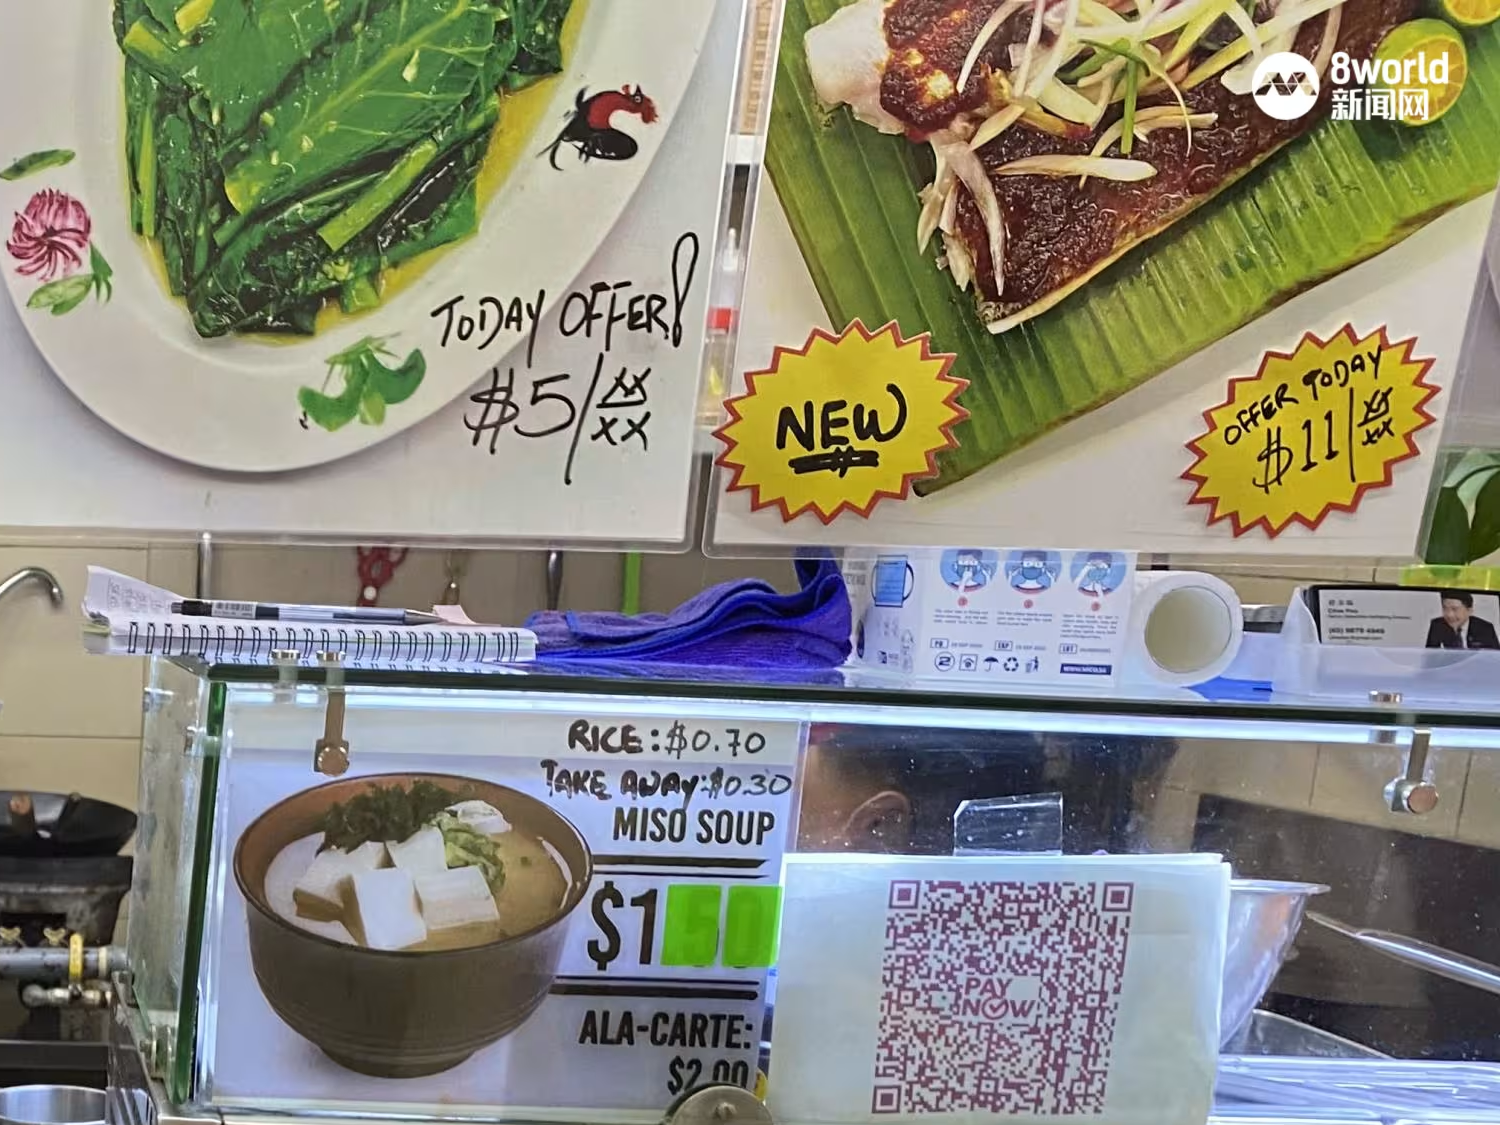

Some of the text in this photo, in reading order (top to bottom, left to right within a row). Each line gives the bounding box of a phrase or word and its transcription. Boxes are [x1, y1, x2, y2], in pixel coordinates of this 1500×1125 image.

[430, 288, 546, 369] TODAY
[1223, 344, 1382, 446] OFFER TODAY
[776, 382, 908, 452] NEW
[540, 758, 613, 800] TAKE
[612, 806, 776, 846] MISO SOUP
[964, 977, 1013, 996] PAY
[961, 996, 1037, 1021] NOW
[578, 1009, 754, 1050] ALA-CARTE:
